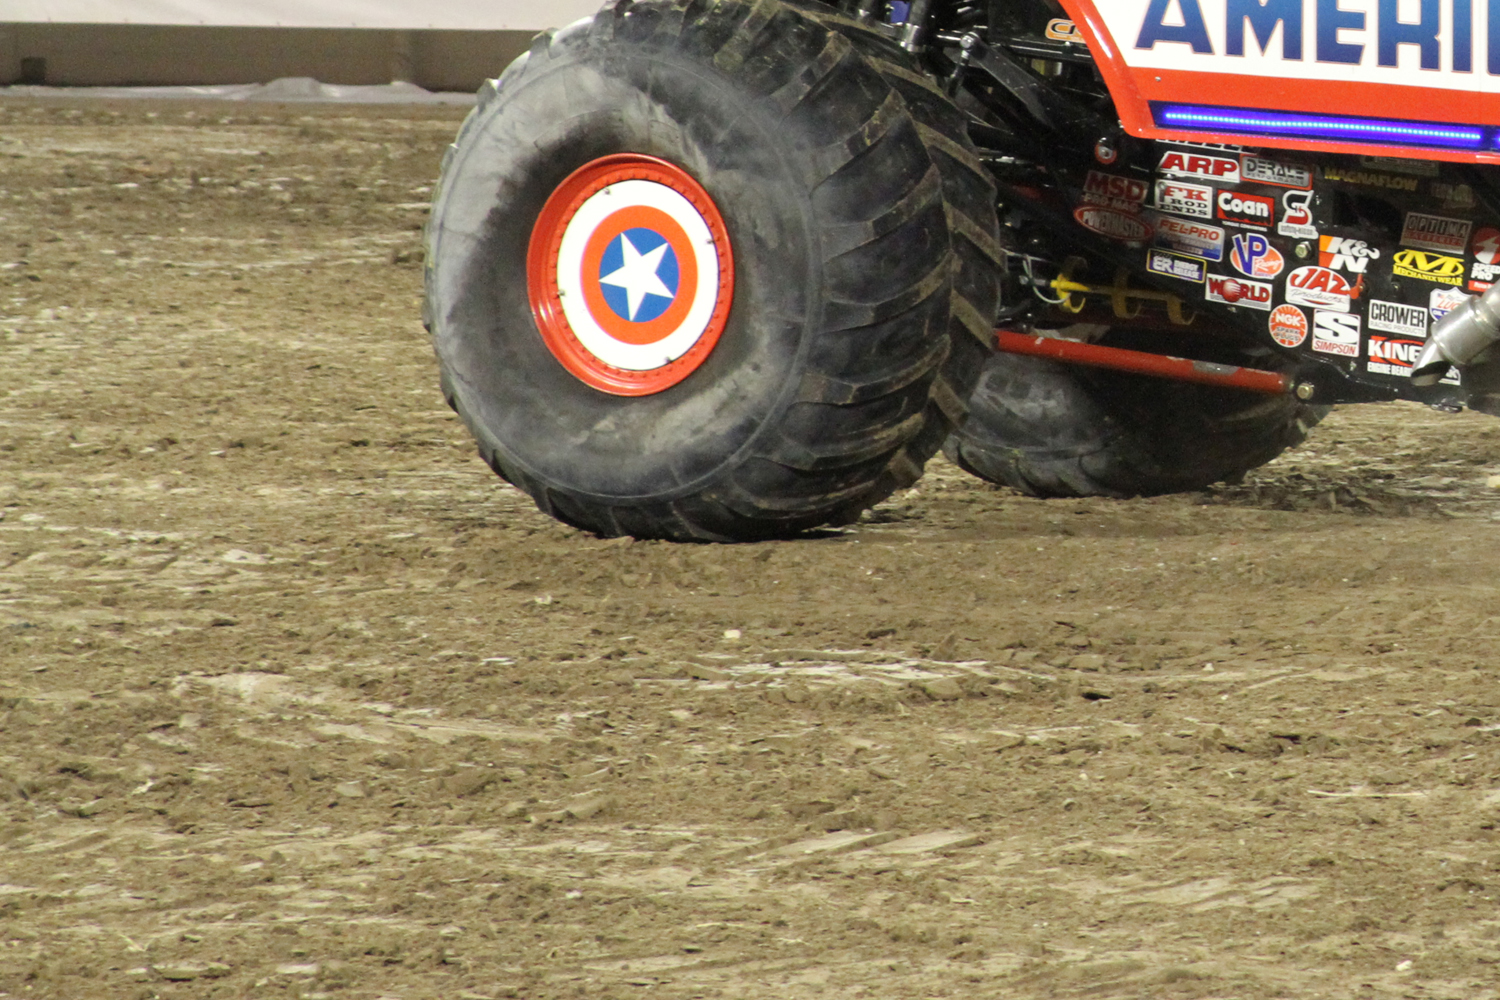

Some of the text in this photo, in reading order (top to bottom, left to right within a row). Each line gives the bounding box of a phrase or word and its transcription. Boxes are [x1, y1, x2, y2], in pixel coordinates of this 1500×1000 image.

[1161, 153, 1238, 177] ARP
[1086, 172, 1145, 201] MSD
[1160, 203, 1208, 216] ENDS
[1171, 198, 1208, 209] ROD
[1218, 192, 1269, 217] Coan
[1406, 215, 1468, 238] OPTIMA
[1234, 234, 1267, 275] VP
[1290, 268, 1347, 296] JAZ
[1470, 270, 1493, 281] PRO
[1275, 313, 1302, 327] NGK
[1371, 302, 1425, 328] CROWER
[1314, 340, 1356, 355] SIMPSON
